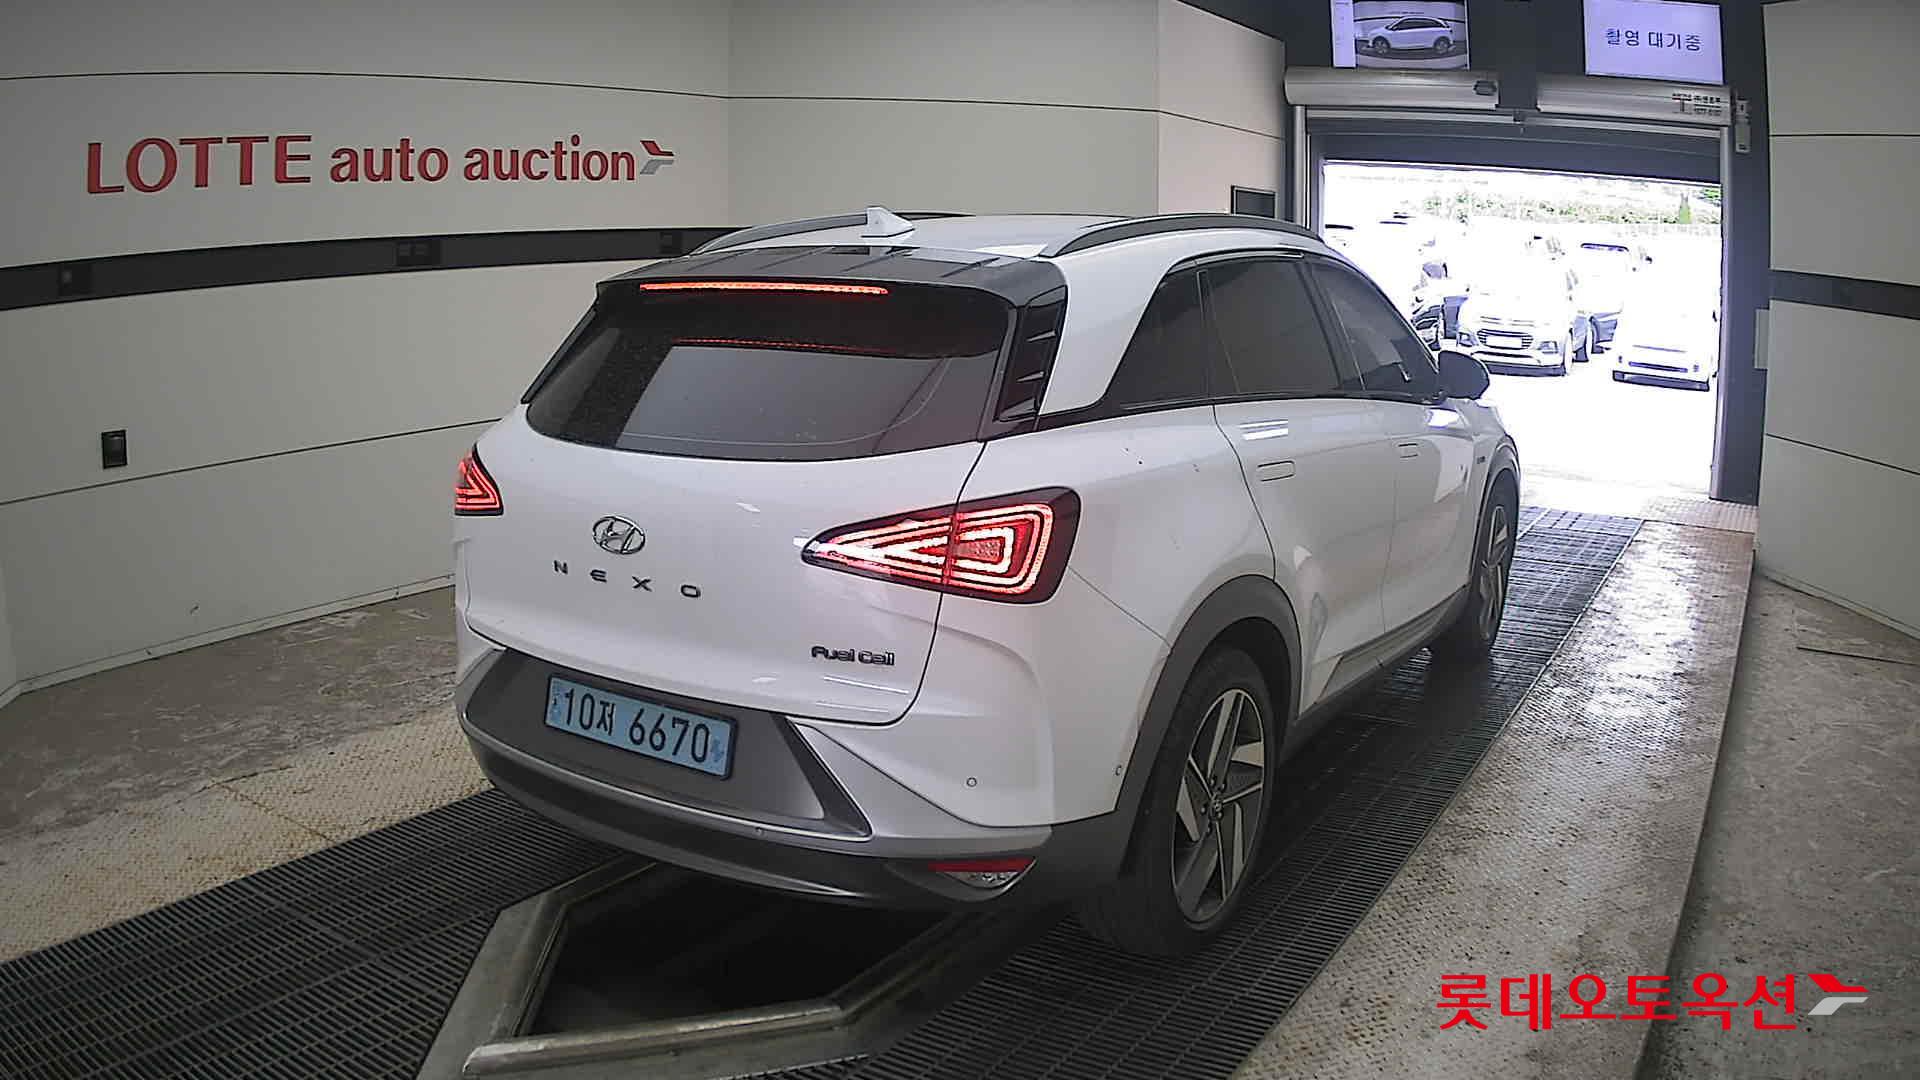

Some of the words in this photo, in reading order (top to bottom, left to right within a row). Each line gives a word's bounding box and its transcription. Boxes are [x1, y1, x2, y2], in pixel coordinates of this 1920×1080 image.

[1648, 31, 1701, 52] 대기중
[87, 135, 312, 194] LOTTE
[330, 137, 449, 182] auto
[463, 134, 636, 182] auction
[553, 559, 702, 599] NEXO
[811, 645, 855, 662] Fuel
[858, 650, 895, 666] Cell
[629, 708, 710, 763] 6670
